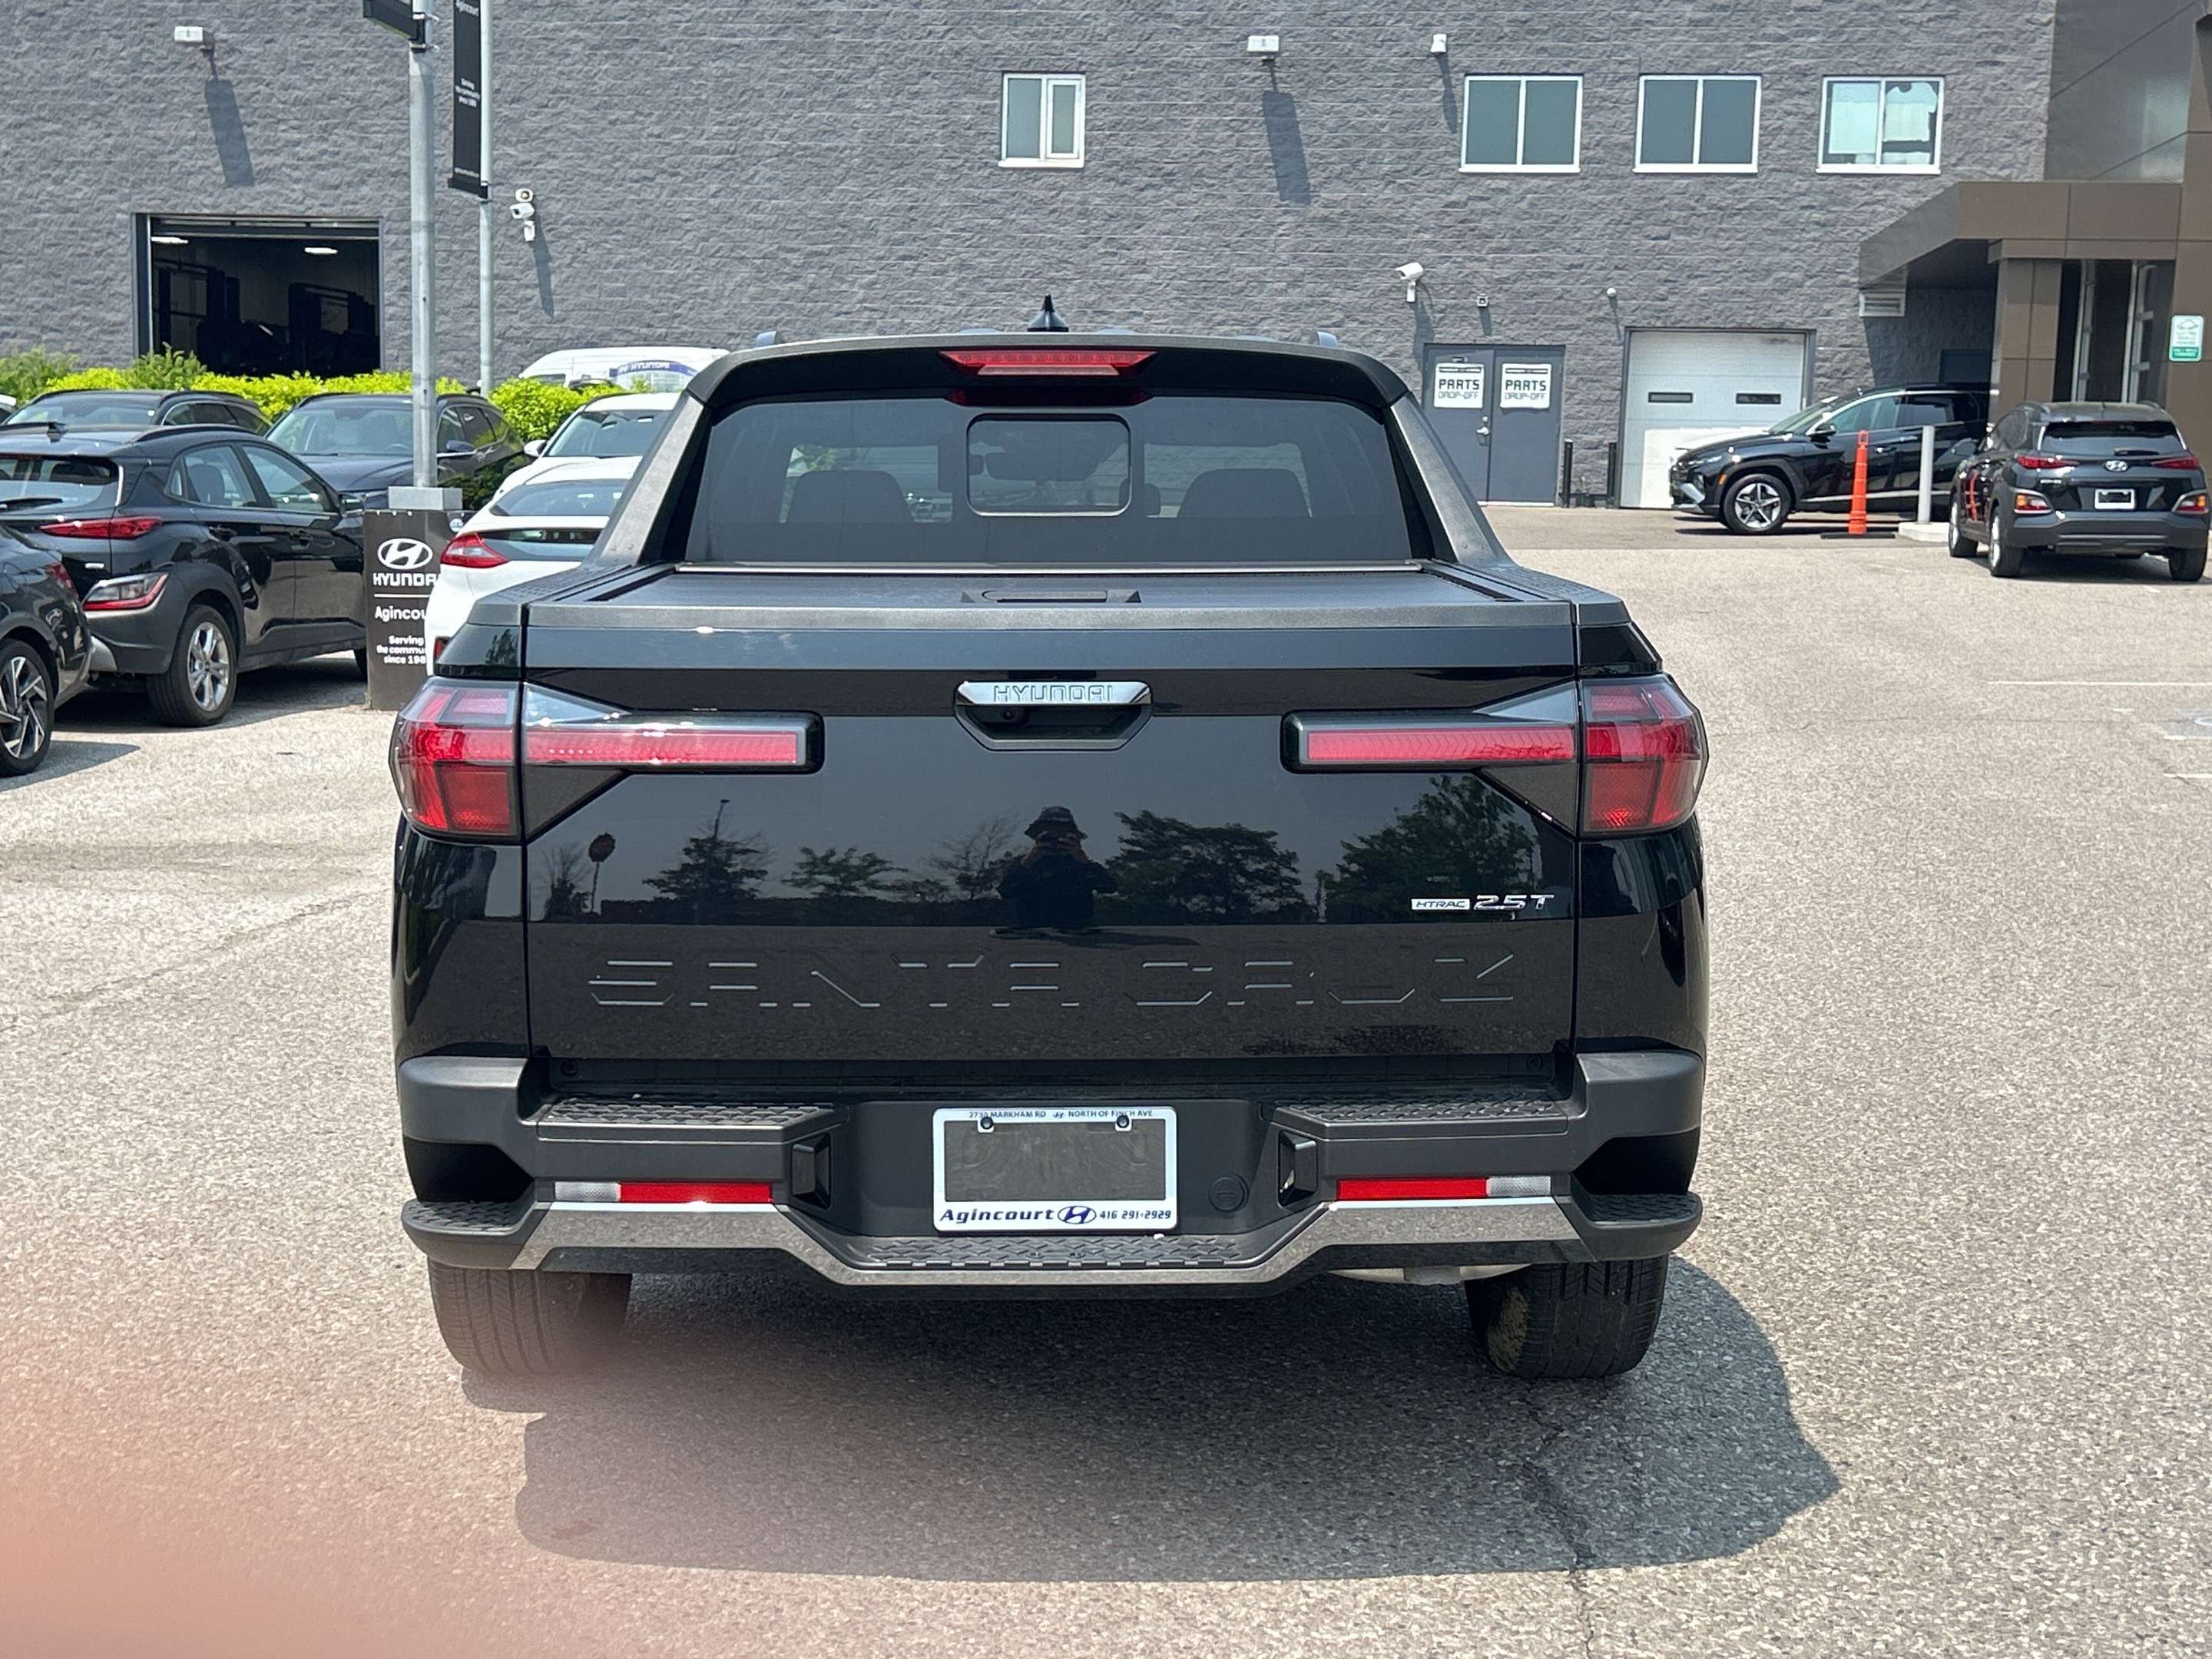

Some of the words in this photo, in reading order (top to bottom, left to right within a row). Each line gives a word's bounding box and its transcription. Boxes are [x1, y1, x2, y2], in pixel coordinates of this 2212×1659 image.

[1439, 379, 1480, 390] PARTS
[1505, 379, 1547, 391] PARTS
[1438, 391, 1479, 399] DROP-OFF
[1505, 392, 1547, 400] DROP-OFF
[375, 605, 426, 622] Agincou
[389, 635, 424, 647] Serving
[993, 684, 1114, 703] HYUNDAI
[1415, 899, 1467, 909] HTRAC
[939, 1207, 1055, 1224] Agincourt
[1099, 1210, 1118, 1220] 416
